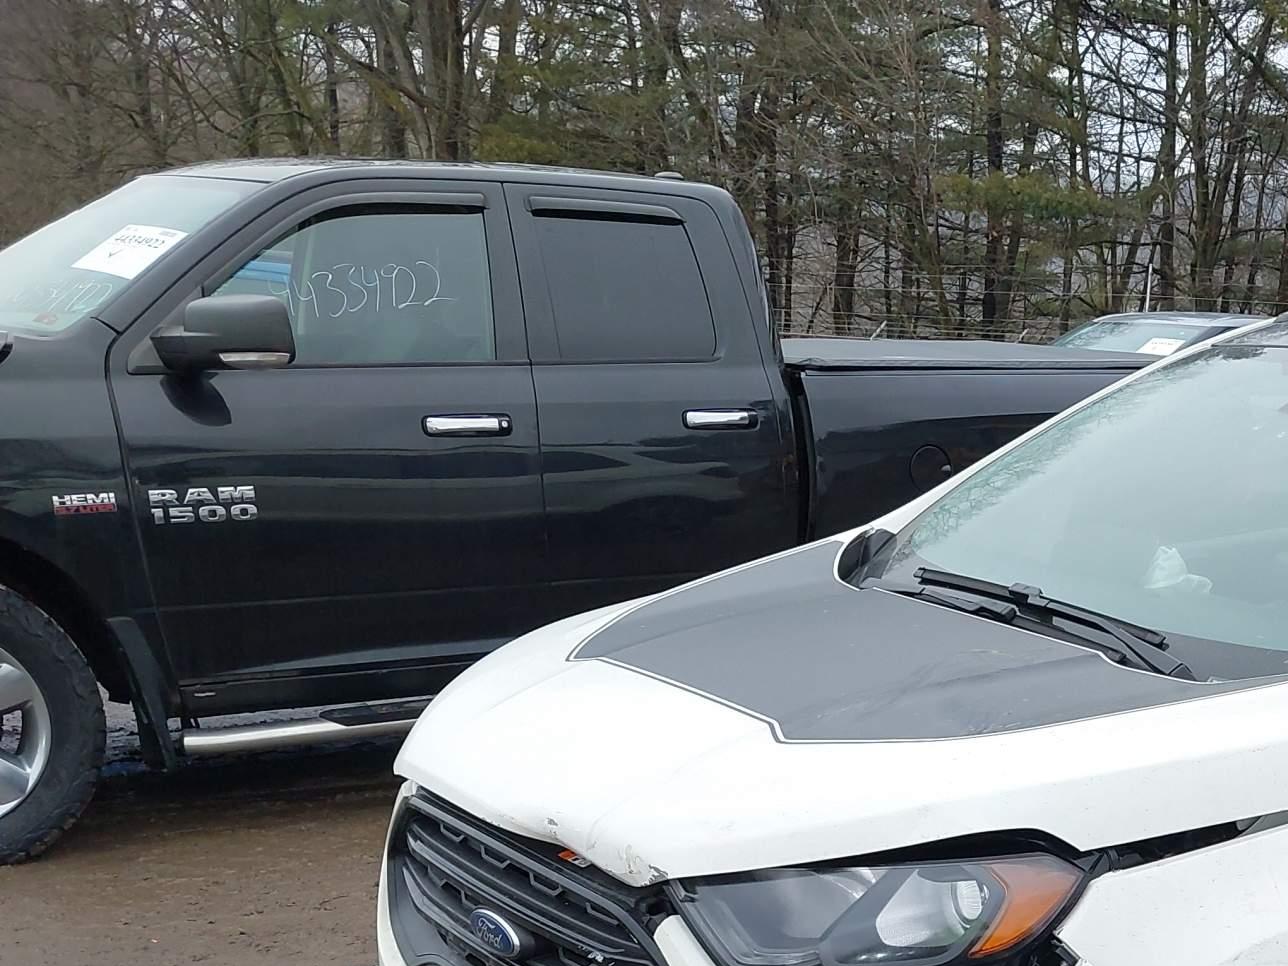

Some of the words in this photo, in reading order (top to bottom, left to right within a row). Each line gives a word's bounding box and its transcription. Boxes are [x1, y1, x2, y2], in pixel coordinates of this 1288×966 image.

[268, 260, 457, 318] 44334922
[52, 492, 115, 506] HEMI
[148, 485, 256, 506] RAM
[151, 504, 258, 525] 1500
[476, 917, 503, 949] Ford
